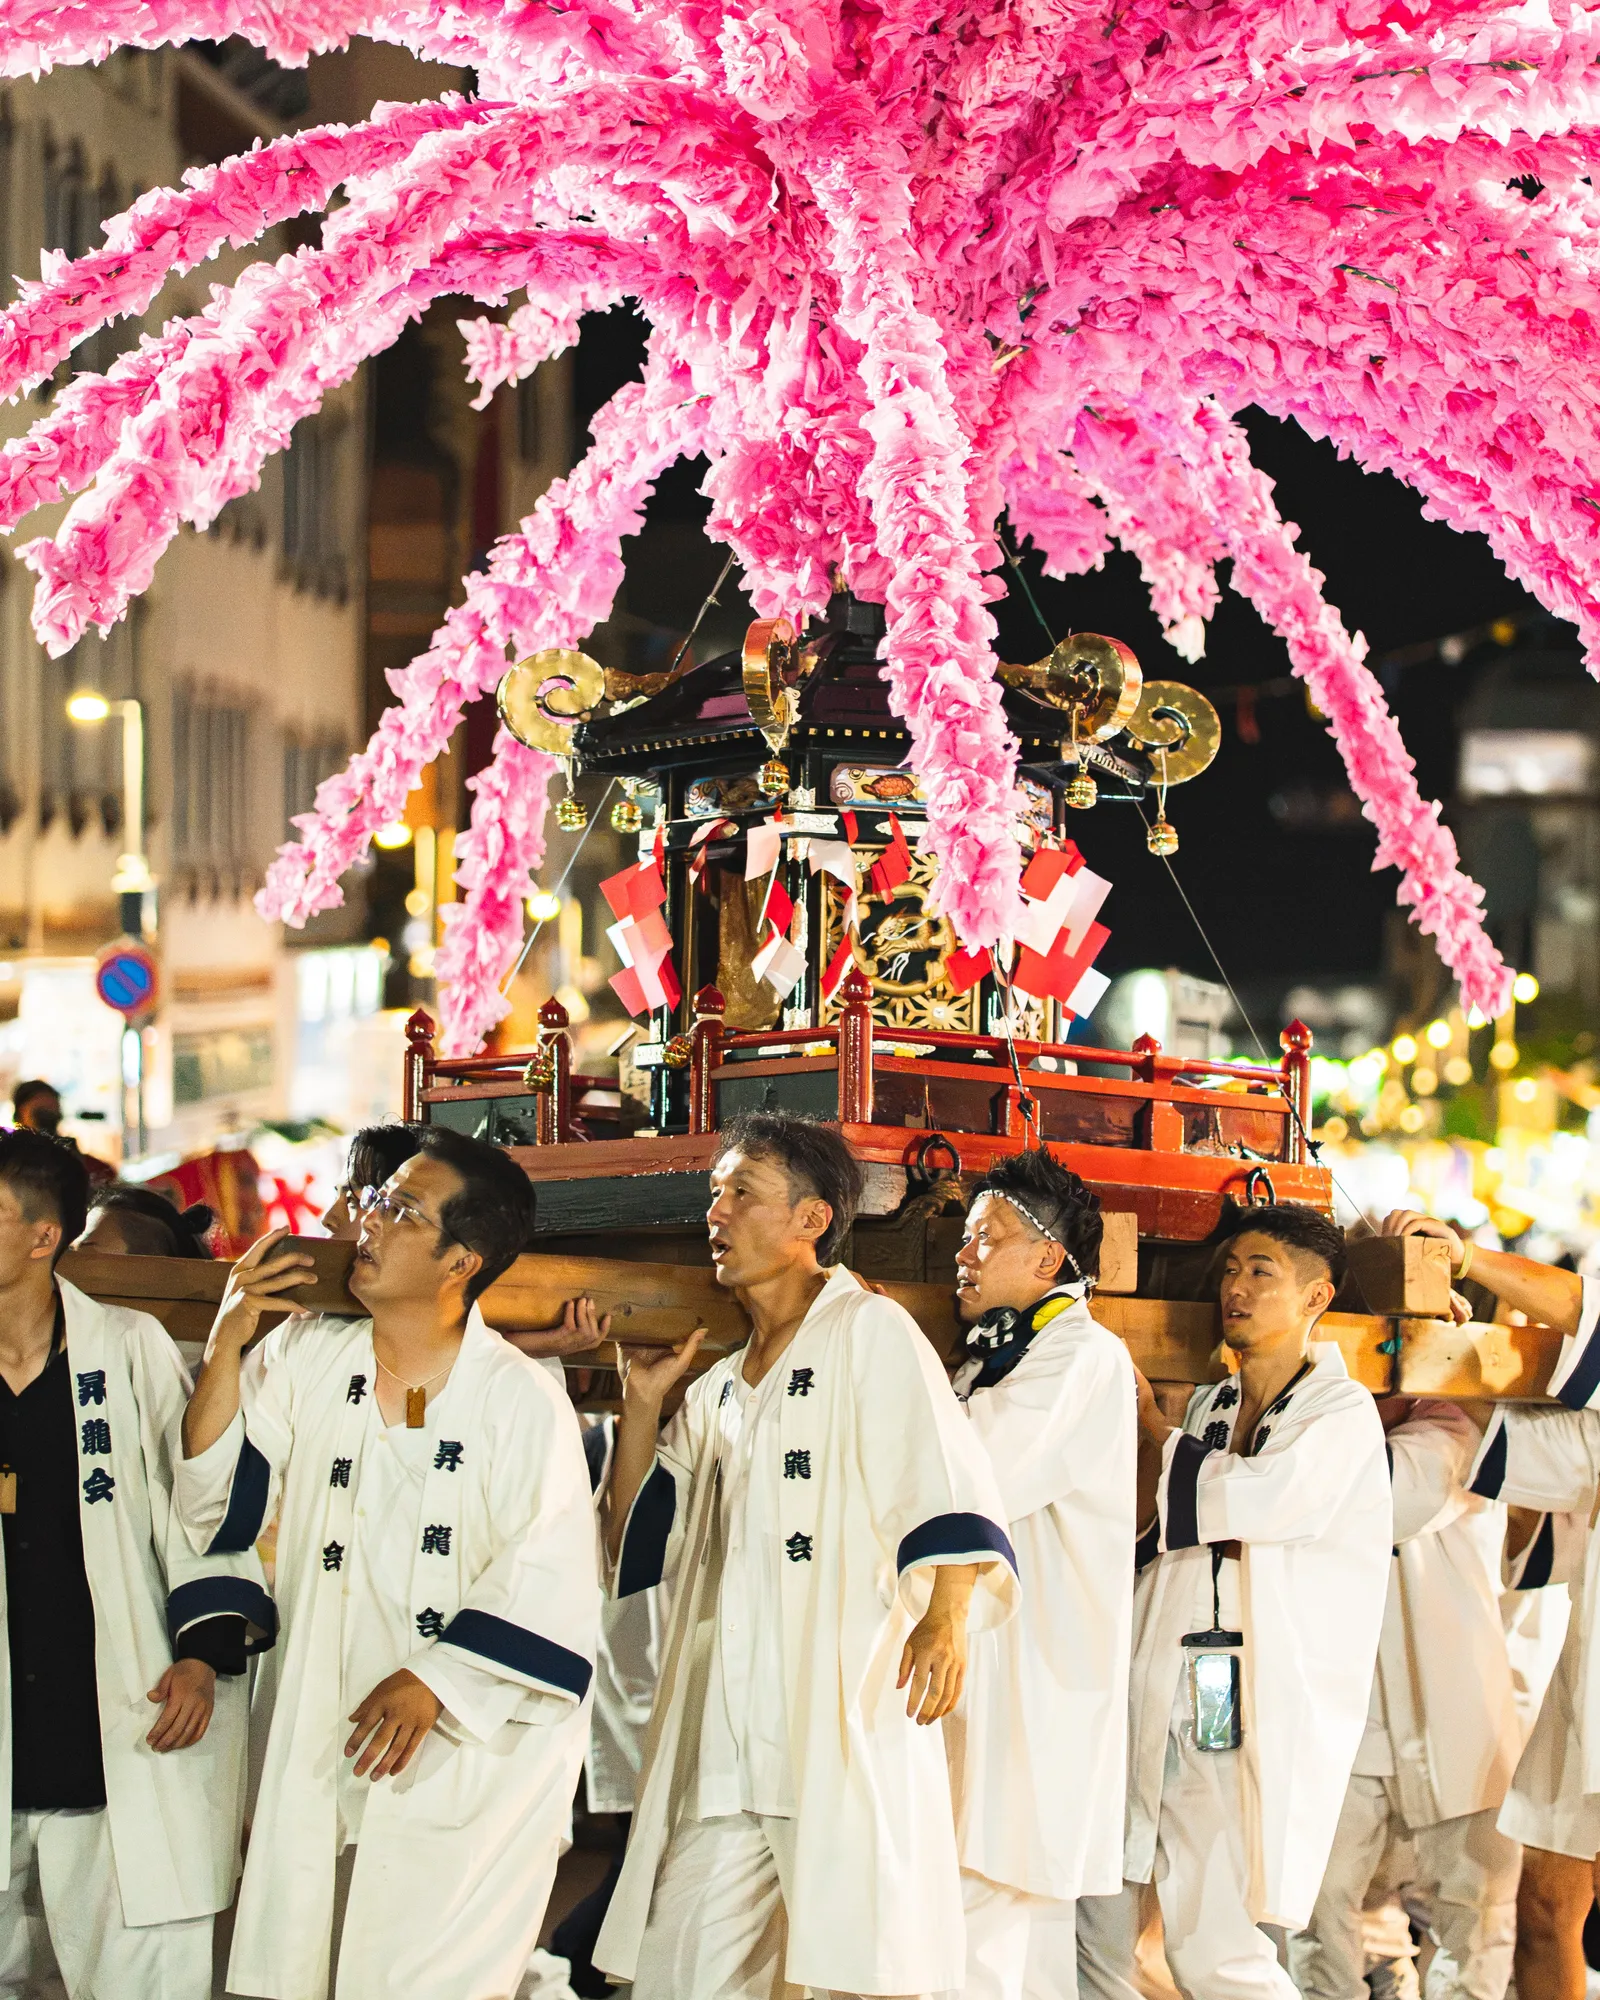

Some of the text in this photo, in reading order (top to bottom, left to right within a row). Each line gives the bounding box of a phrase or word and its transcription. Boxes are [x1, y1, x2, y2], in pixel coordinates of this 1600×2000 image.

[76, 1369, 116, 1505] 昇龍会
[783, 1367, 815, 1563] 昇龍会
[416, 1439, 464, 1639] 昇龍会
